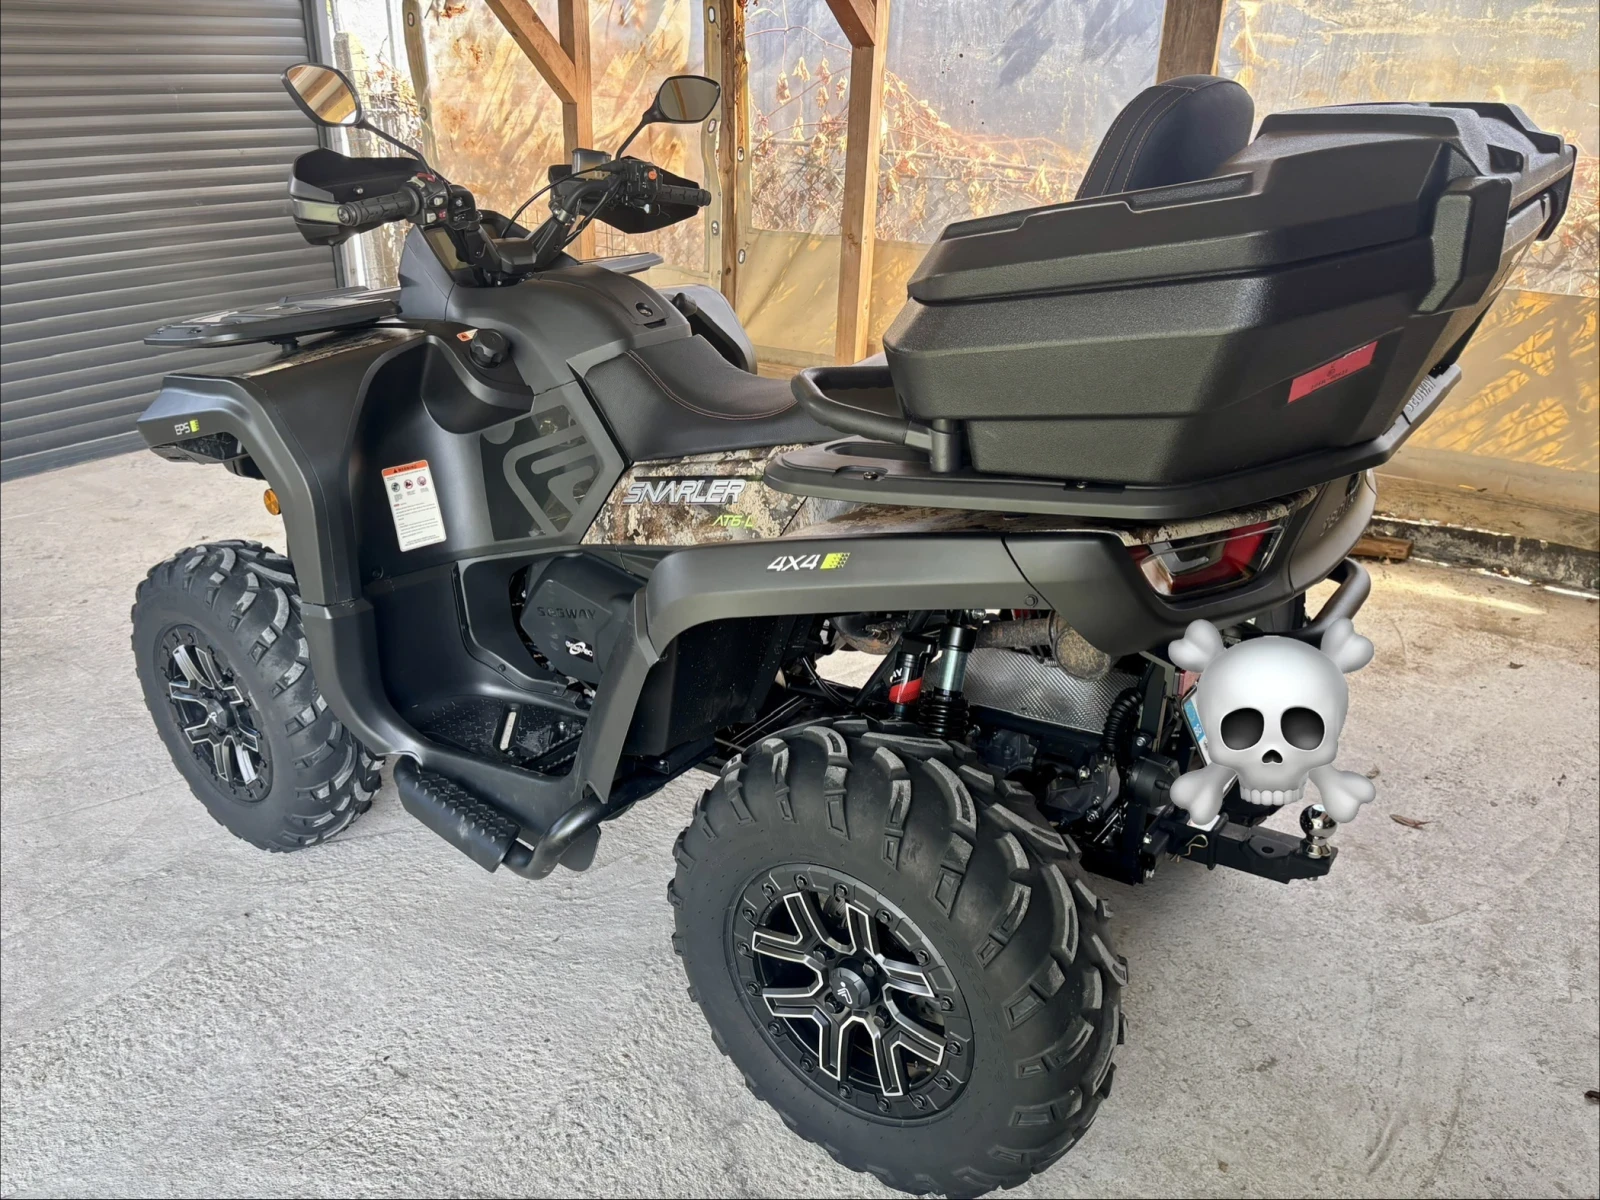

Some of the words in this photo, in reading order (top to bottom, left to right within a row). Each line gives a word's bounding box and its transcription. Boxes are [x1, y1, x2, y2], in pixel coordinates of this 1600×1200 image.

[174, 422, 191, 435] EPS
[622, 479, 747, 505] SNARLER
[766, 554, 821, 571] 4X4
[536, 606, 596, 619] SEGWAY
